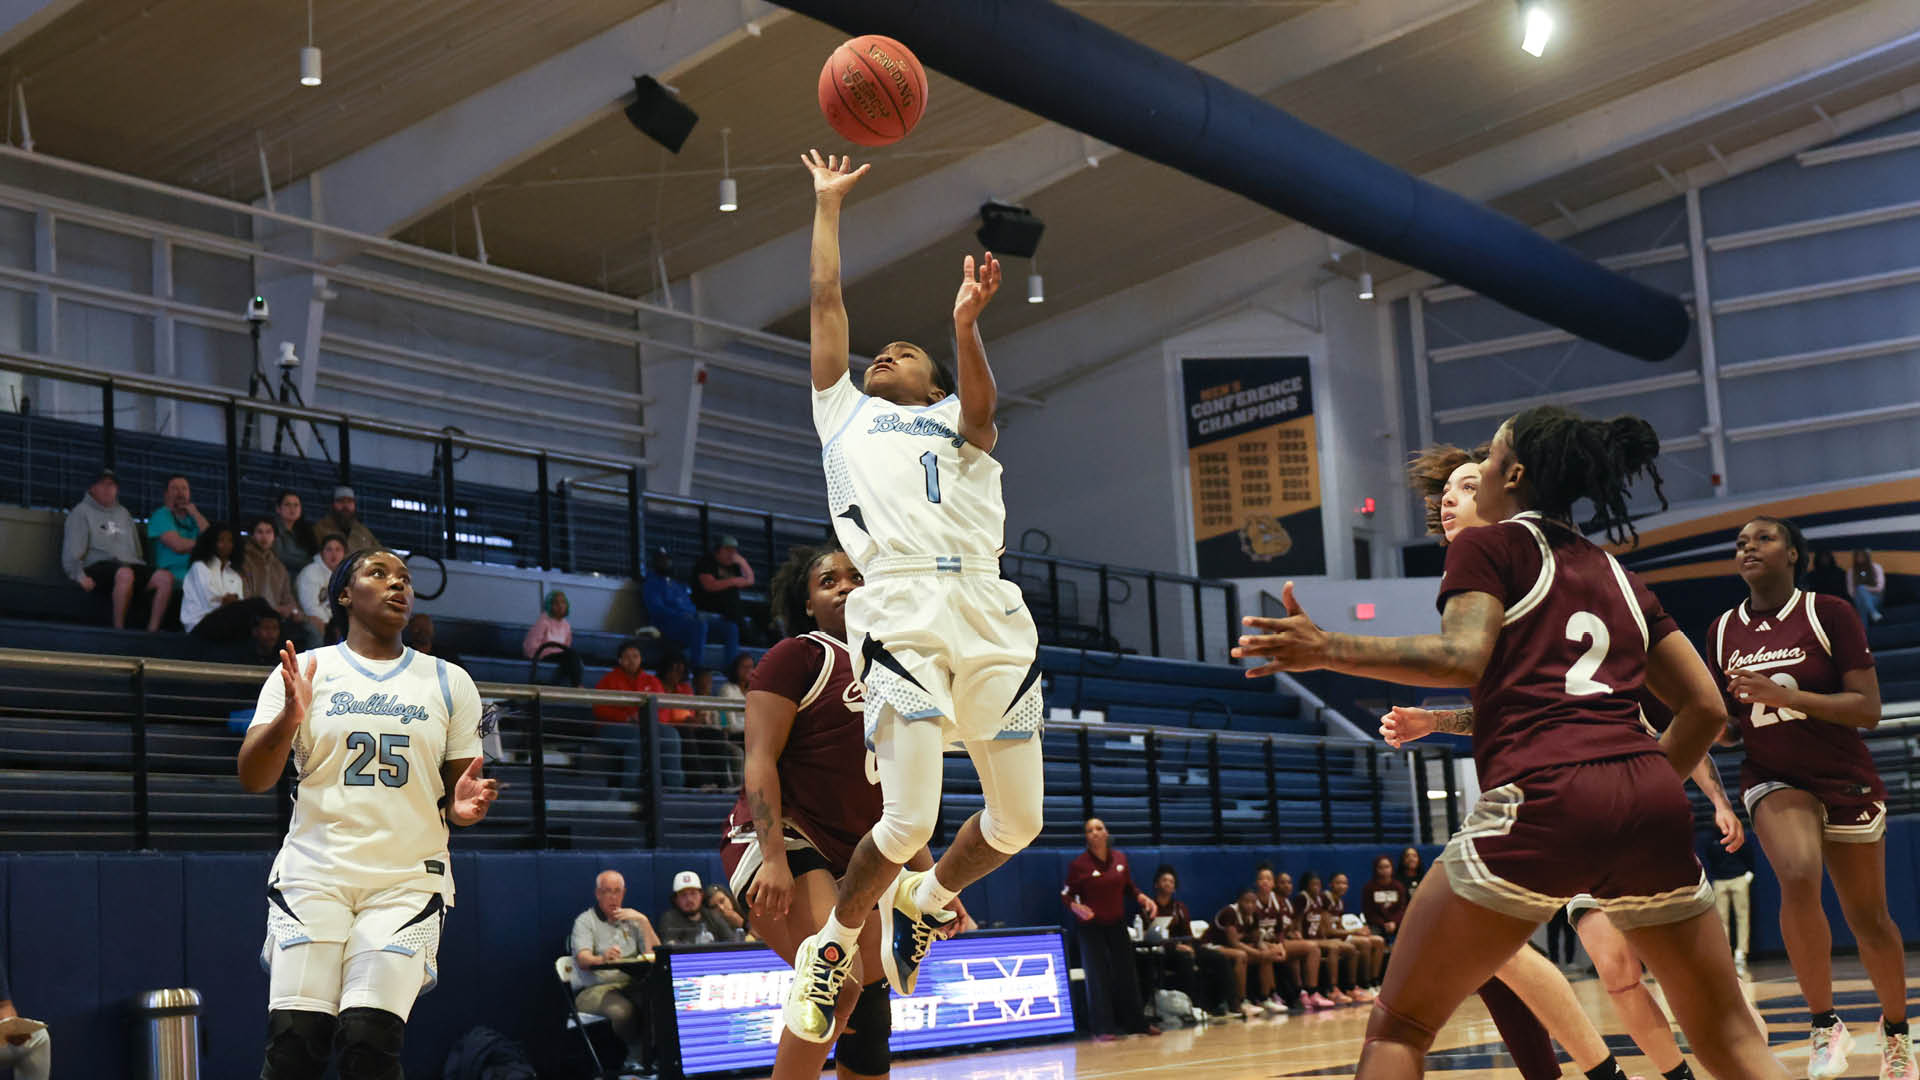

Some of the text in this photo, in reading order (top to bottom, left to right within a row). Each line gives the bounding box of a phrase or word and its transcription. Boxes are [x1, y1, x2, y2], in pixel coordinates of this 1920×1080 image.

[1191, 376, 1303, 419] CONFERENCE
[1199, 395, 1298, 435] CHAMPIONS
[867, 412, 968, 448] Bulldog
[919, 450, 941, 504] 1
[1564, 610, 1614, 696] 2
[1728, 646, 1803, 672] Coahoma
[326, 691, 429, 724] Bulldogs
[344, 731, 410, 788] 25
